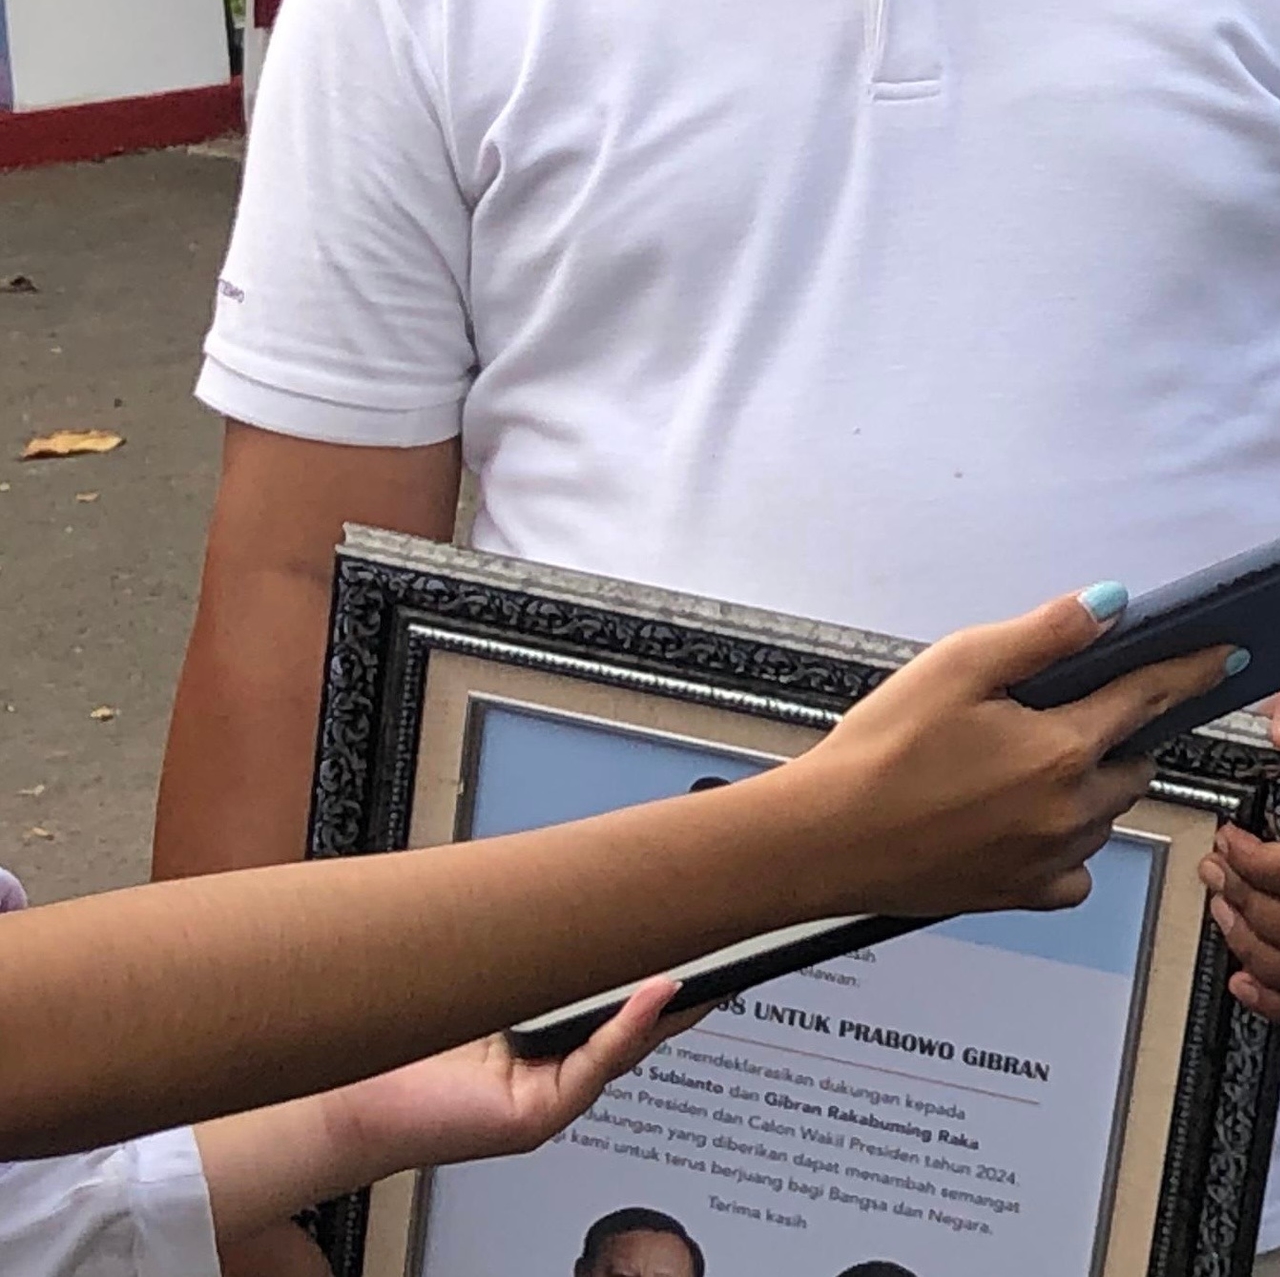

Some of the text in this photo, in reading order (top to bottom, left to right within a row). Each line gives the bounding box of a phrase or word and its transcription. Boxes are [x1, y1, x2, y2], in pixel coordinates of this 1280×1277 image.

[677, 1047, 814, 1087] mendeklarasikan
[819, 1076, 901, 1105] dukungan
[905, 1094, 966, 1120] kepada
[755, 1002, 830, 1035] UNTUK
[839, 1020, 955, 1061] PRABOWO
[962, 1047, 1050, 1082] GIBRAN
[638, 1090, 709, 1118] Presiden
[713, 1108, 744, 1125] dan
[748, 1115, 796, 1137] Calon
[801, 1127, 845, 1148] Wakil
[849, 1136, 920, 1164] Presiden
[924, 1155, 971, 1176] tahun
[649, 1066, 724, 1095] Subianto
[729, 1085, 760, 1102] dan
[764, 1091, 823, 1117] Gibran
[828, 1105, 932, 1143] Rakabuming
[938, 1129, 980, 1150] Raka
[571, 1129, 610, 1150] kami
[614, 1141, 660, 1162] untuk
[665, 1152, 706, 1172] terus
[711, 1161, 783, 1193] berjuang
[788, 1177, 824, 1200] bagi
[829, 1186, 888, 1212] Bangsa
[893, 1201, 923, 1219] dan
[667, 1127, 707, 1148] yang
[712, 1136, 788, 1162] diberikan
[793, 1154, 840, 1175] dapat
[845, 1166, 937, 1196] menambah
[940, 1187, 1021, 1213] semangat
[708, 1195, 808, 1229] Terima kasih
